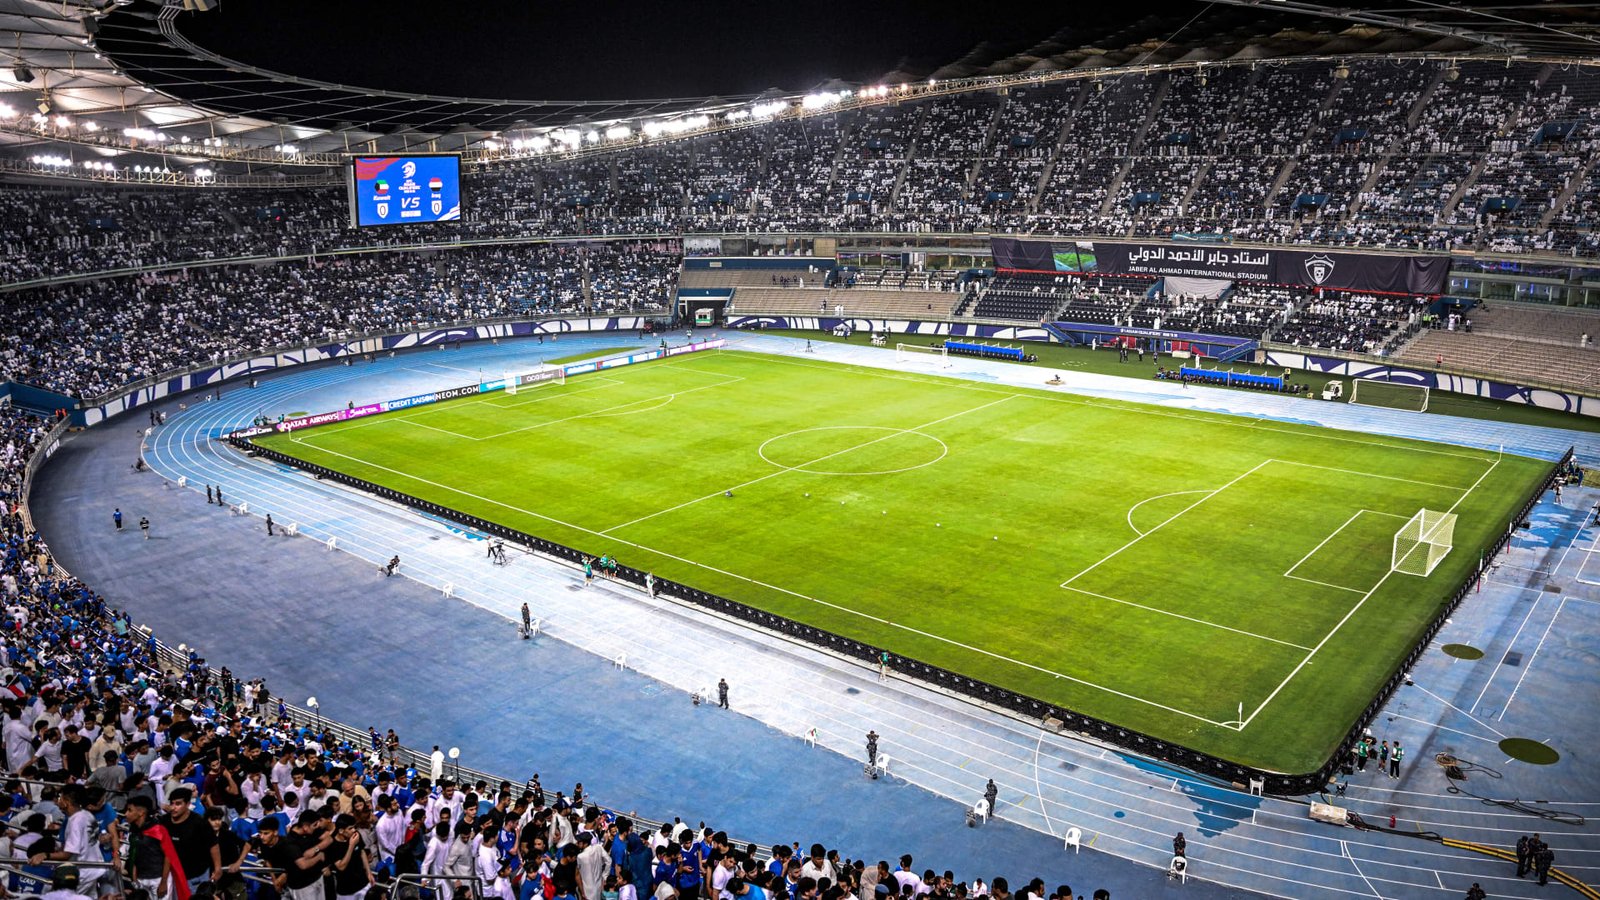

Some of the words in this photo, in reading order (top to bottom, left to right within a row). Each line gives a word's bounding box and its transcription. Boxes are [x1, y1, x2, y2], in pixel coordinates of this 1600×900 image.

[401, 197, 421, 208] VS
[434, 202, 440, 213] 0
[380, 205, 386, 216] 0
[1128, 246, 1165, 265] الدولي
[1168, 249, 1204, 262] الأحمد
[1206, 250, 1229, 266] جابر
[1231, 251, 1269, 266] استاد
[1158, 267, 1183, 275] AHMAD
[1183, 268, 1236, 279] INTERNATIONAL
[1237, 272, 1268, 280] STADIUM
[435, 385, 480, 401] NEOM.COM
[389, 398, 411, 409] CREDIT
[284, 418, 308, 430] QATAR
[309, 413, 338, 424] AIRWAYS
